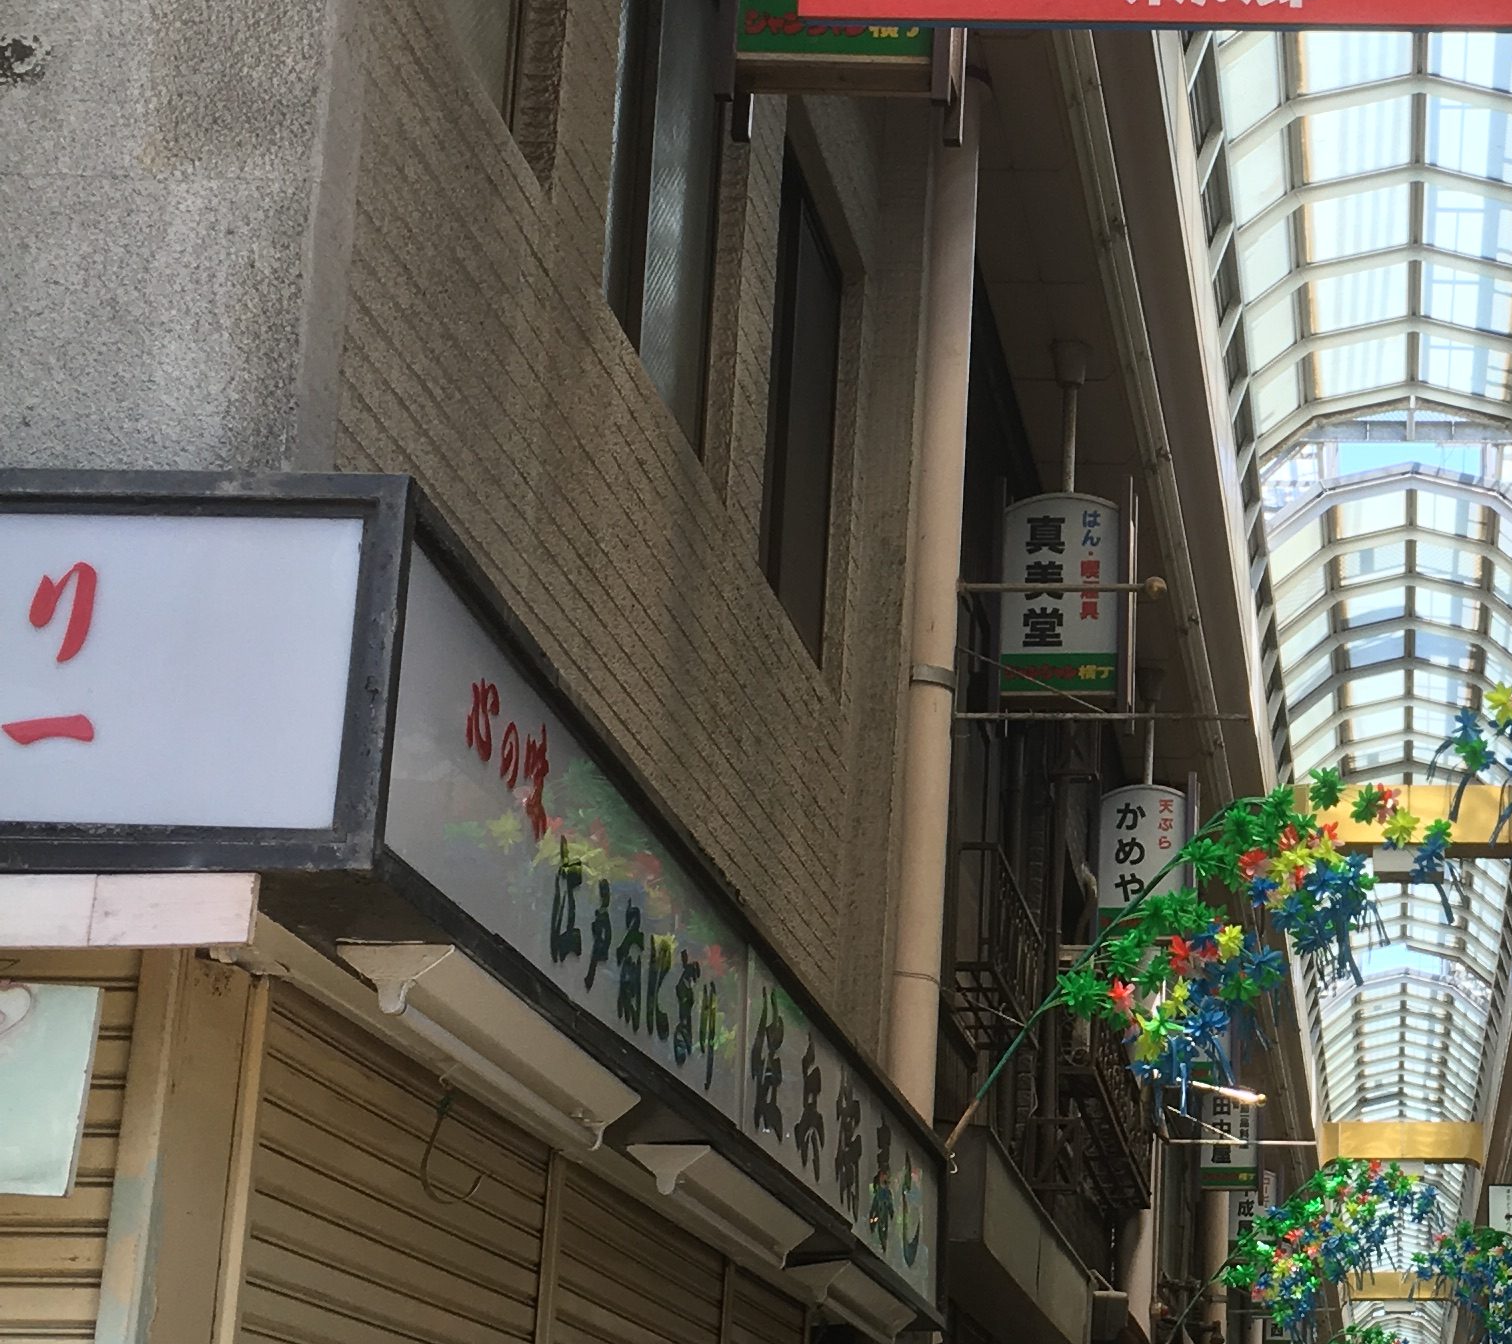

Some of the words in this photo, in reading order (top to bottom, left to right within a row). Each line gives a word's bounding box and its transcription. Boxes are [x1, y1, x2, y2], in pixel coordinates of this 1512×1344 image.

[1022, 516, 1065, 647] 真美堂
[466, 677, 550, 843] 心の味
[1114, 802, 1147, 902] かめや
[1158, 799, 1175, 850] 天ぷら
